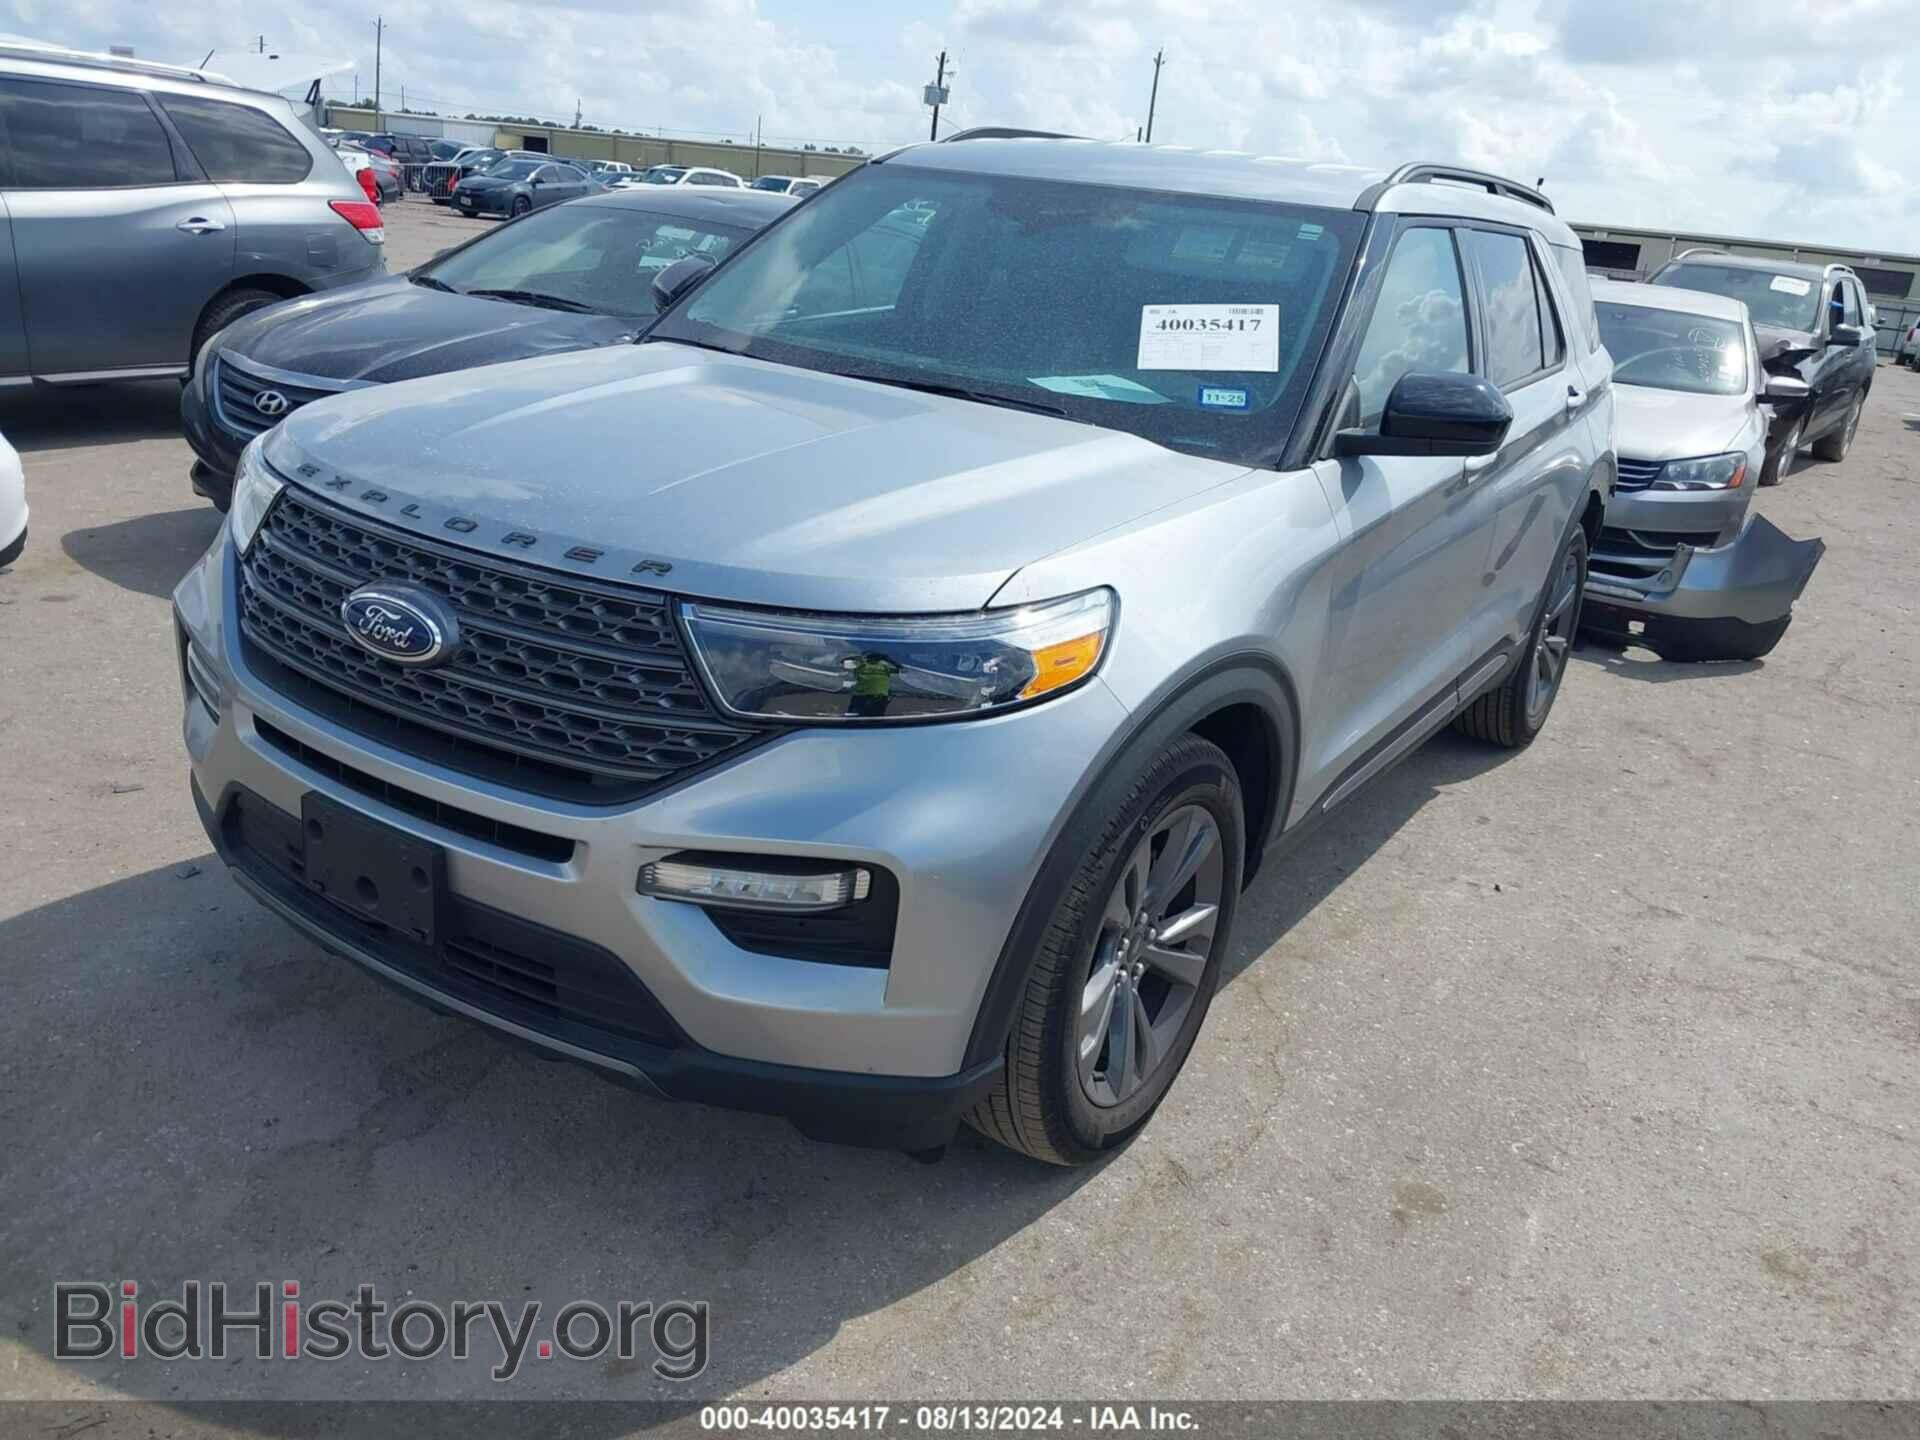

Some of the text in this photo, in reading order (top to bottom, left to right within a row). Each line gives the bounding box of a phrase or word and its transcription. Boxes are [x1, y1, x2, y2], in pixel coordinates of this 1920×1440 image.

[1155, 318, 1262, 332] 40035417
[297, 462, 673, 577] EXPLORER
[357, 604, 414, 649] Ford
